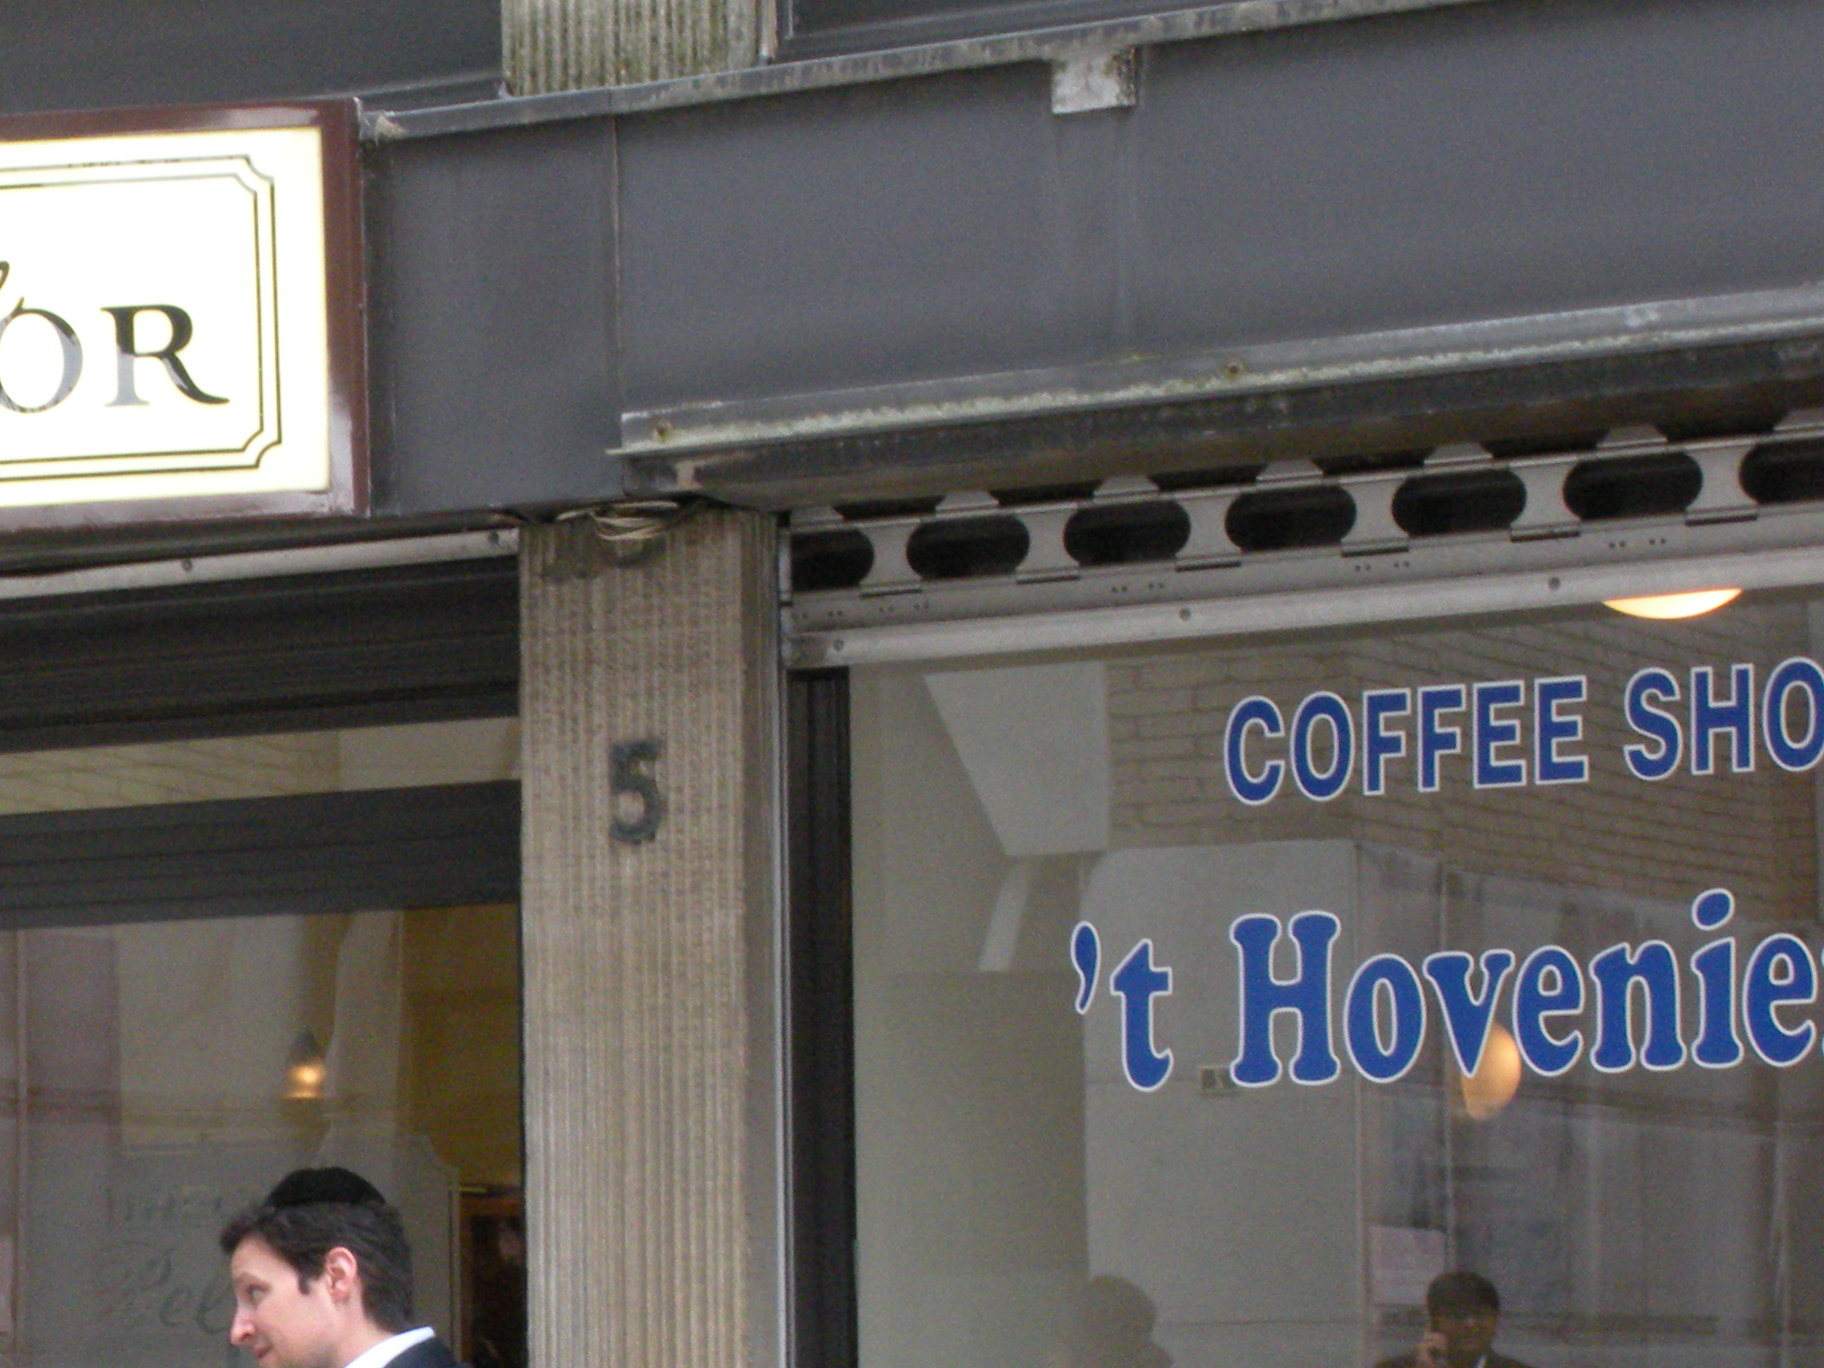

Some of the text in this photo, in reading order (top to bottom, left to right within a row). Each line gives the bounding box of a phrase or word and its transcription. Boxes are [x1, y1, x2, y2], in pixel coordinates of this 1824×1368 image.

[609, 737, 667, 846] 5
[1224, 657, 1824, 804] COFFEE SHO
[1069, 887, 1824, 1093] 't Hovenie
